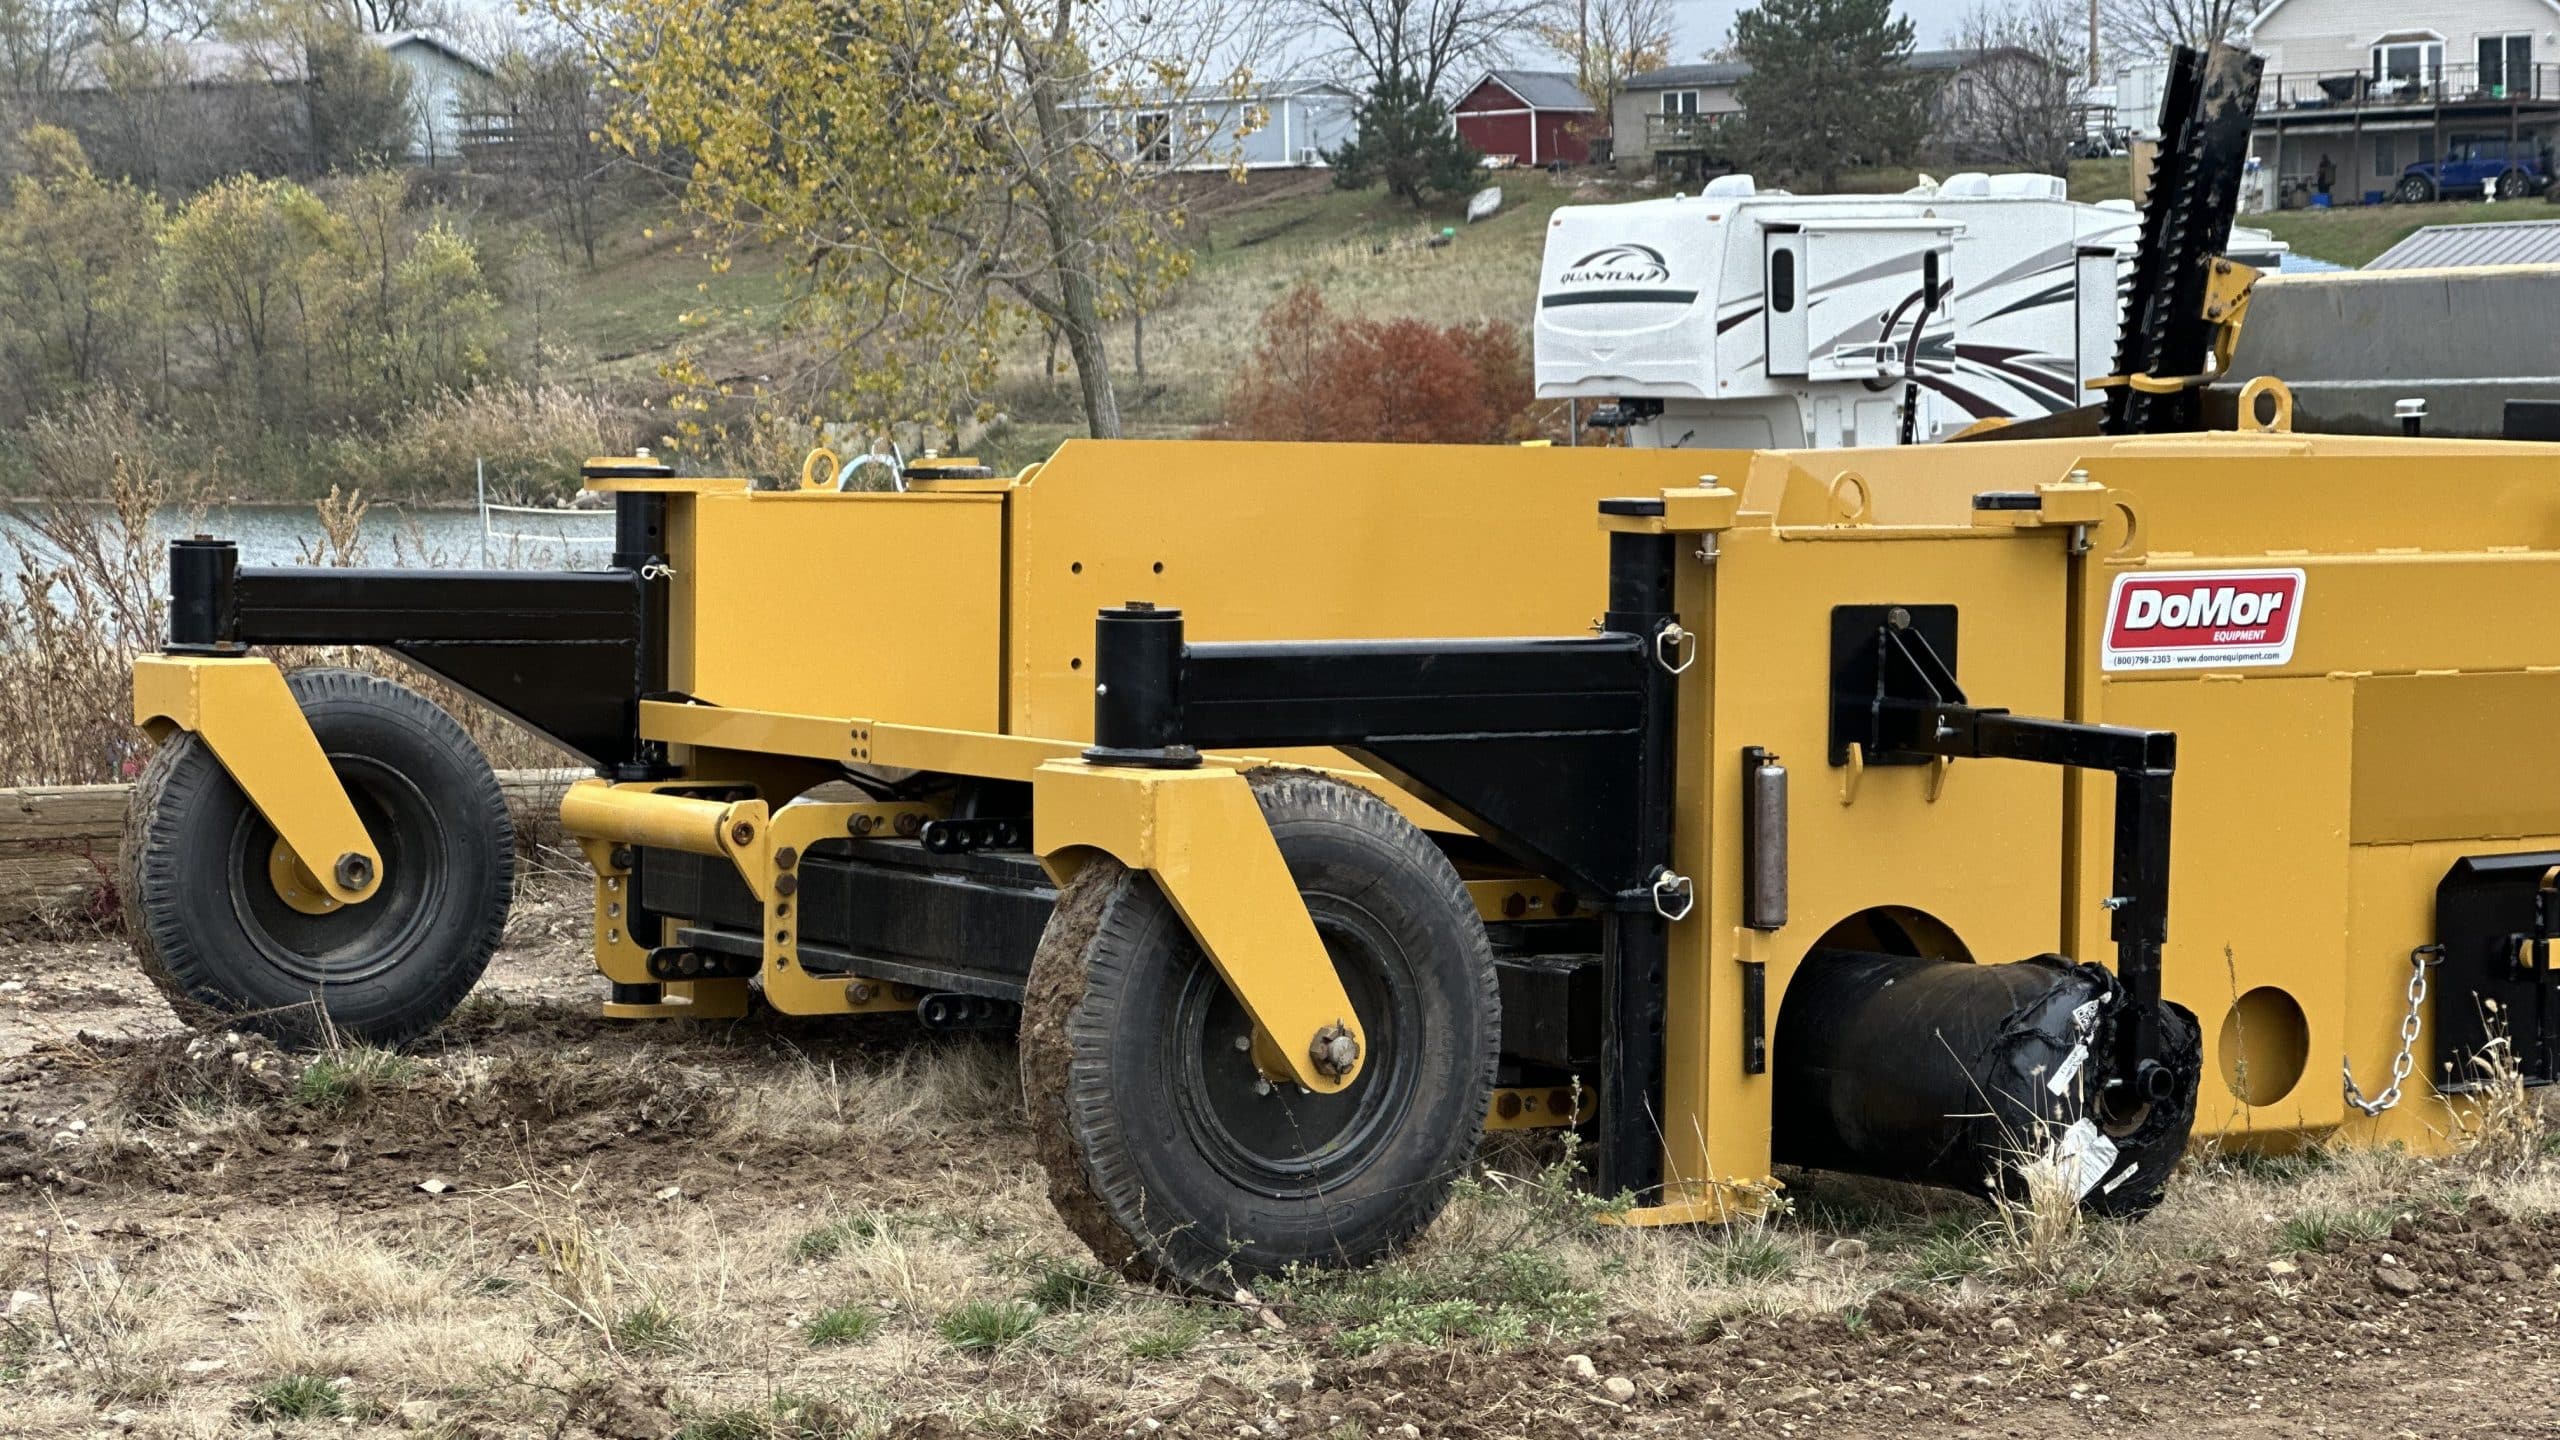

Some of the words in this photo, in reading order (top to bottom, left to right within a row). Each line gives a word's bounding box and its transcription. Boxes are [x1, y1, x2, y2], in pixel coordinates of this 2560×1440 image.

[1560, 270, 1645, 285] QUANTUM
[2124, 587, 2284, 629] DoMor
[2213, 630, 2266, 642] EQUIPMENT
[2177, 652, 2280, 663] www.domorequipment.com
